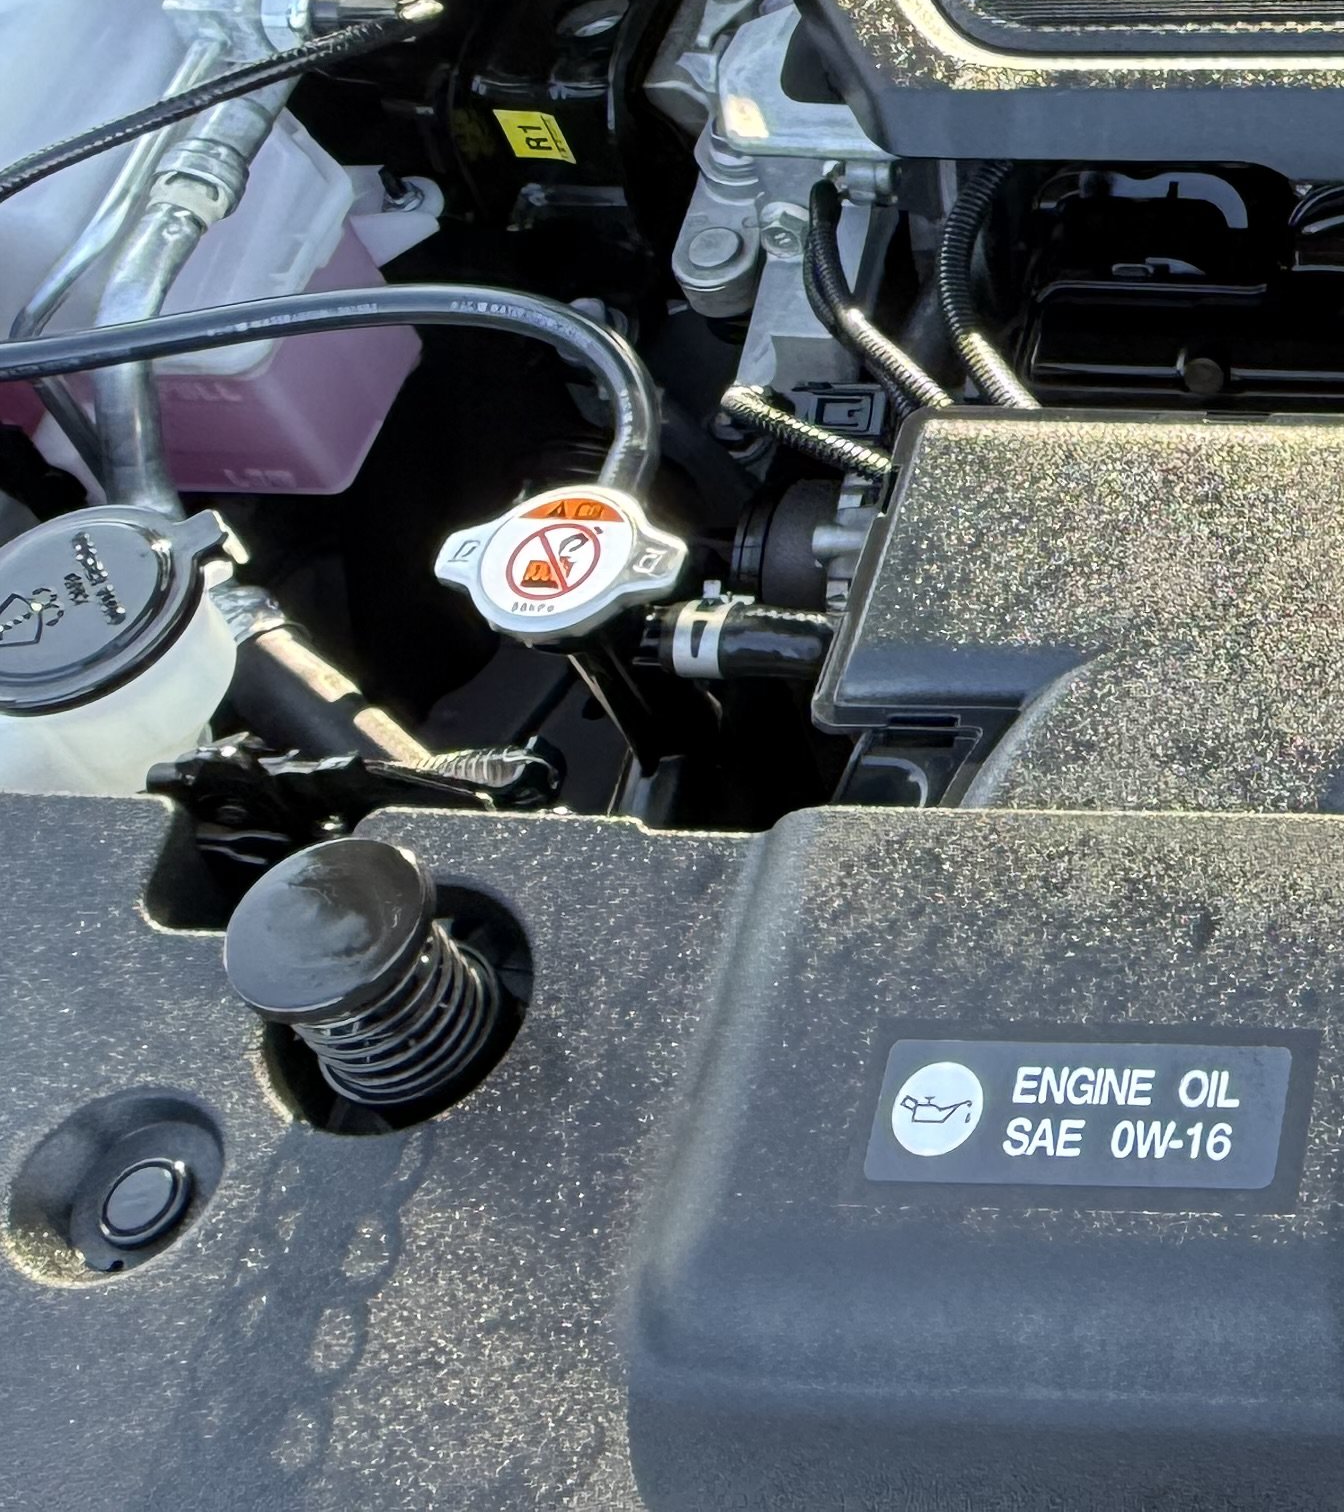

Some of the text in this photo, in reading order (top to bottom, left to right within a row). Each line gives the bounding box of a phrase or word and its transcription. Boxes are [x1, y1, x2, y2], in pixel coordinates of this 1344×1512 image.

[1011, 1065, 1241, 1109] ENGINE OIL
[1002, 1117, 1233, 1162] SAE 0W-16
